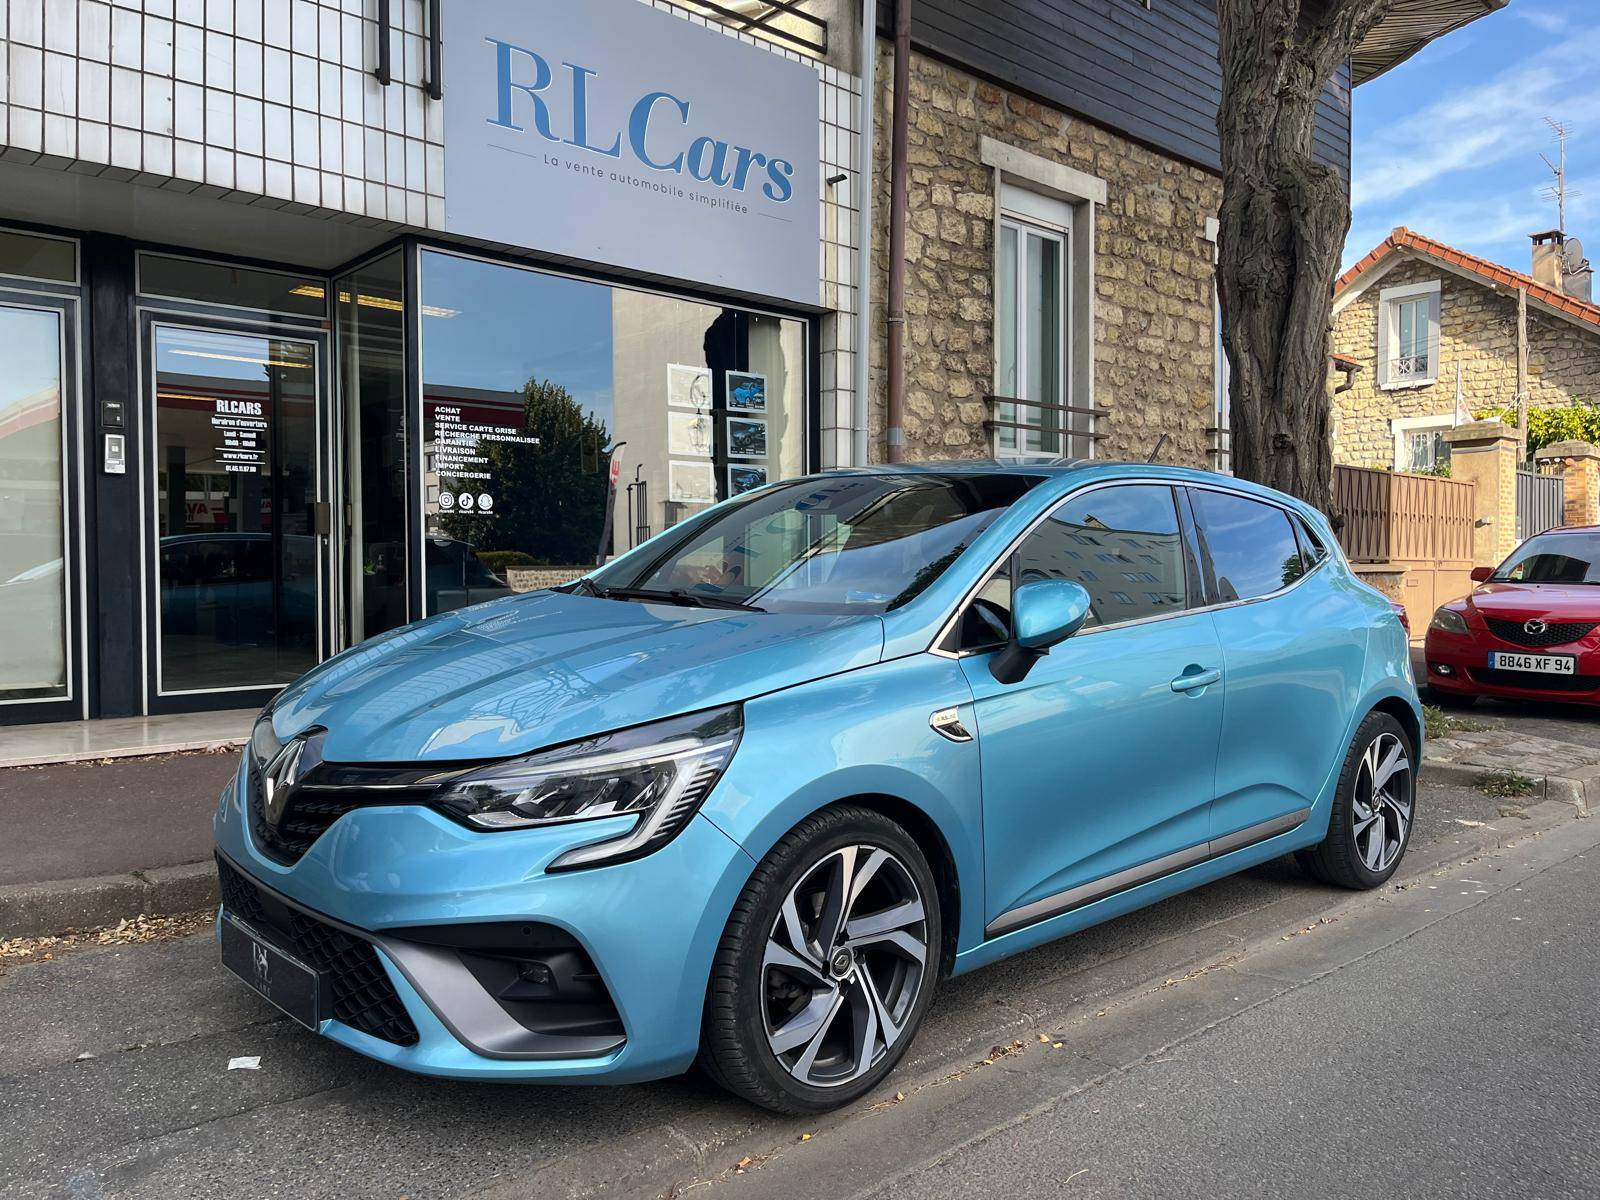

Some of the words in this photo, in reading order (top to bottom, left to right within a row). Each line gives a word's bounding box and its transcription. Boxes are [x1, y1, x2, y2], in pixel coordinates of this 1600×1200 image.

[544, 153, 559, 167] La
[566, 162, 604, 178] vente
[610, 172, 684, 198] automobile
[689, 191, 748, 214] simplifiée
[216, 400, 262, 415] RLCARS
[435, 406, 461, 414] ACHAT
[435, 414, 460, 422] VENTE
[435, 422, 467, 430] SERVICE
[469, 425, 493, 433] CARTE
[495, 427, 517, 435] GRISE
[435, 430, 480, 439] RECHERCHE
[435, 438, 474, 447] GARANTIE
[435, 446, 476, 455] LIVRAISON
[435, 454, 489, 463] FINANCEMENT
[435, 462, 465, 470] IMPORT
[435, 470, 492, 479] CONCIERGERIE
[1499, 655, 1532, 669] 8846
[1535, 657, 1550, 670] XF
[1554, 659, 1571, 672] 94
